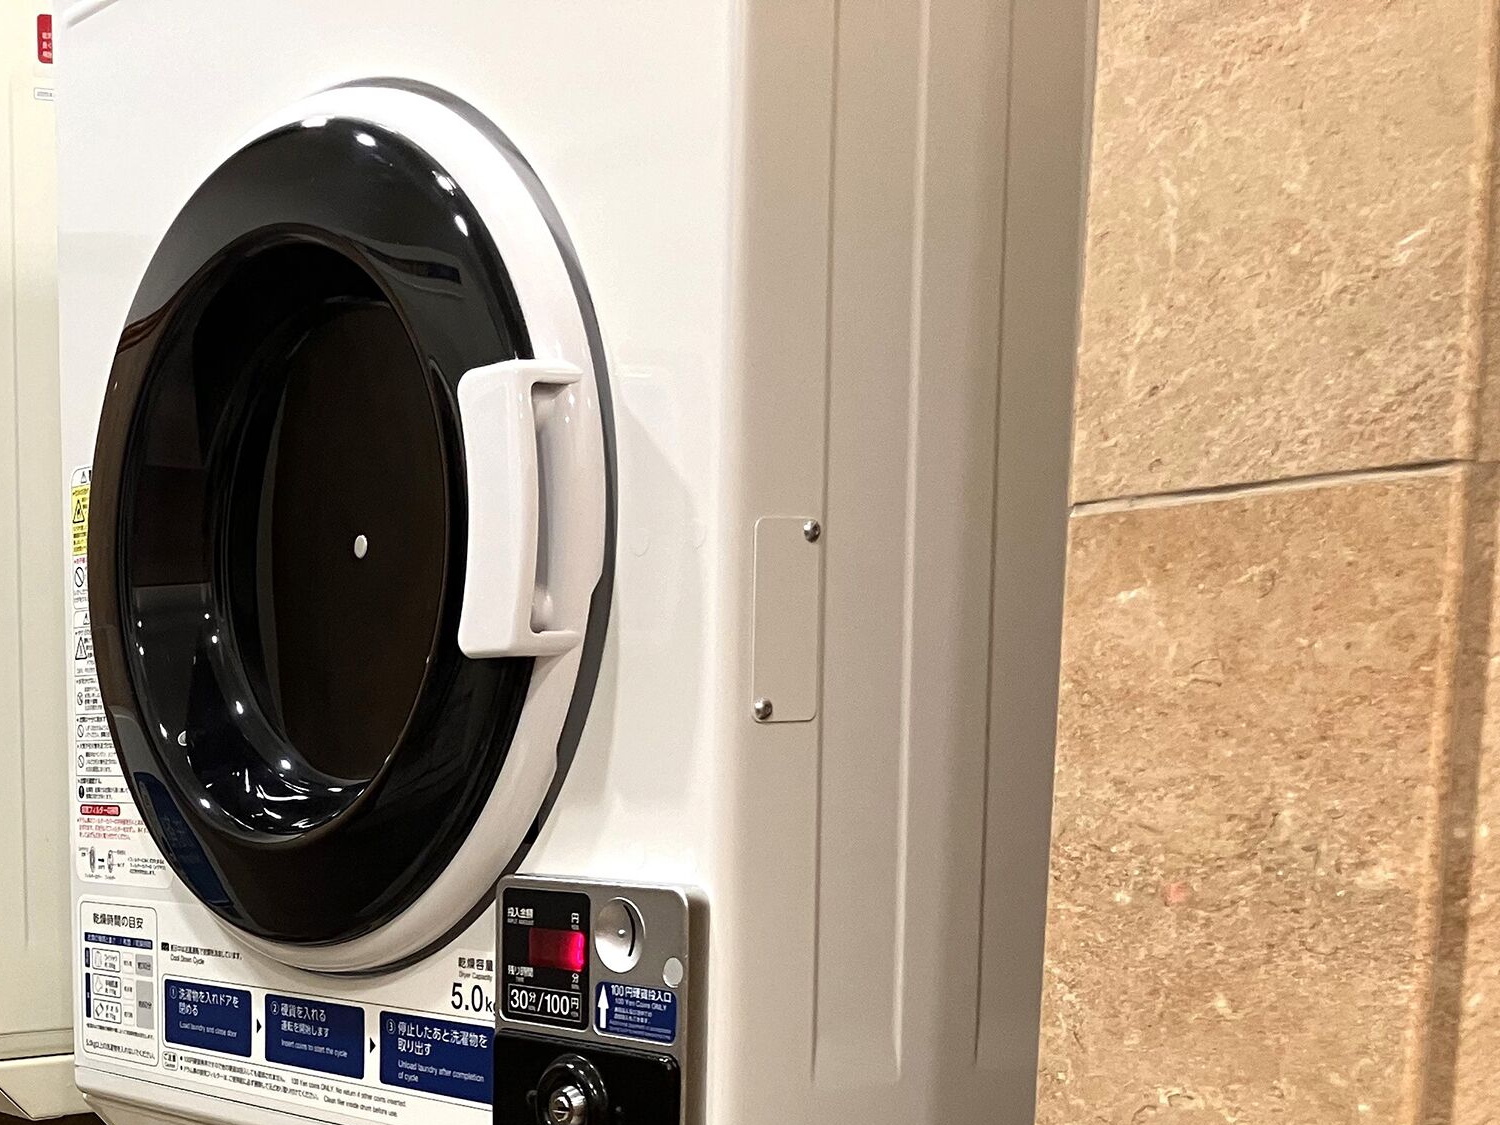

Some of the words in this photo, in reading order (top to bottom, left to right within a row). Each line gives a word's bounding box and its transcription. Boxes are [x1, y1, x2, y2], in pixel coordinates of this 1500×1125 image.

[93, 912, 144, 929] 乾燥時間の目安
[571, 912, 580, 924] 円
[458, 957, 493, 972] 乾燥容量
[571, 973, 579, 984] 分
[178, 988, 240, 1008] 洗濯物を入れドアを
[178, 1002, 199, 1016] 閉める
[280, 1003, 327, 1022] 硬貨を入れる
[281, 1019, 330, 1038] 運転を開始します
[398, 1021, 488, 1049] 停止したあと洗濯物を
[398, 1038, 432, 1056] 取り出す
[452, 1070, 485, 1083] completion
